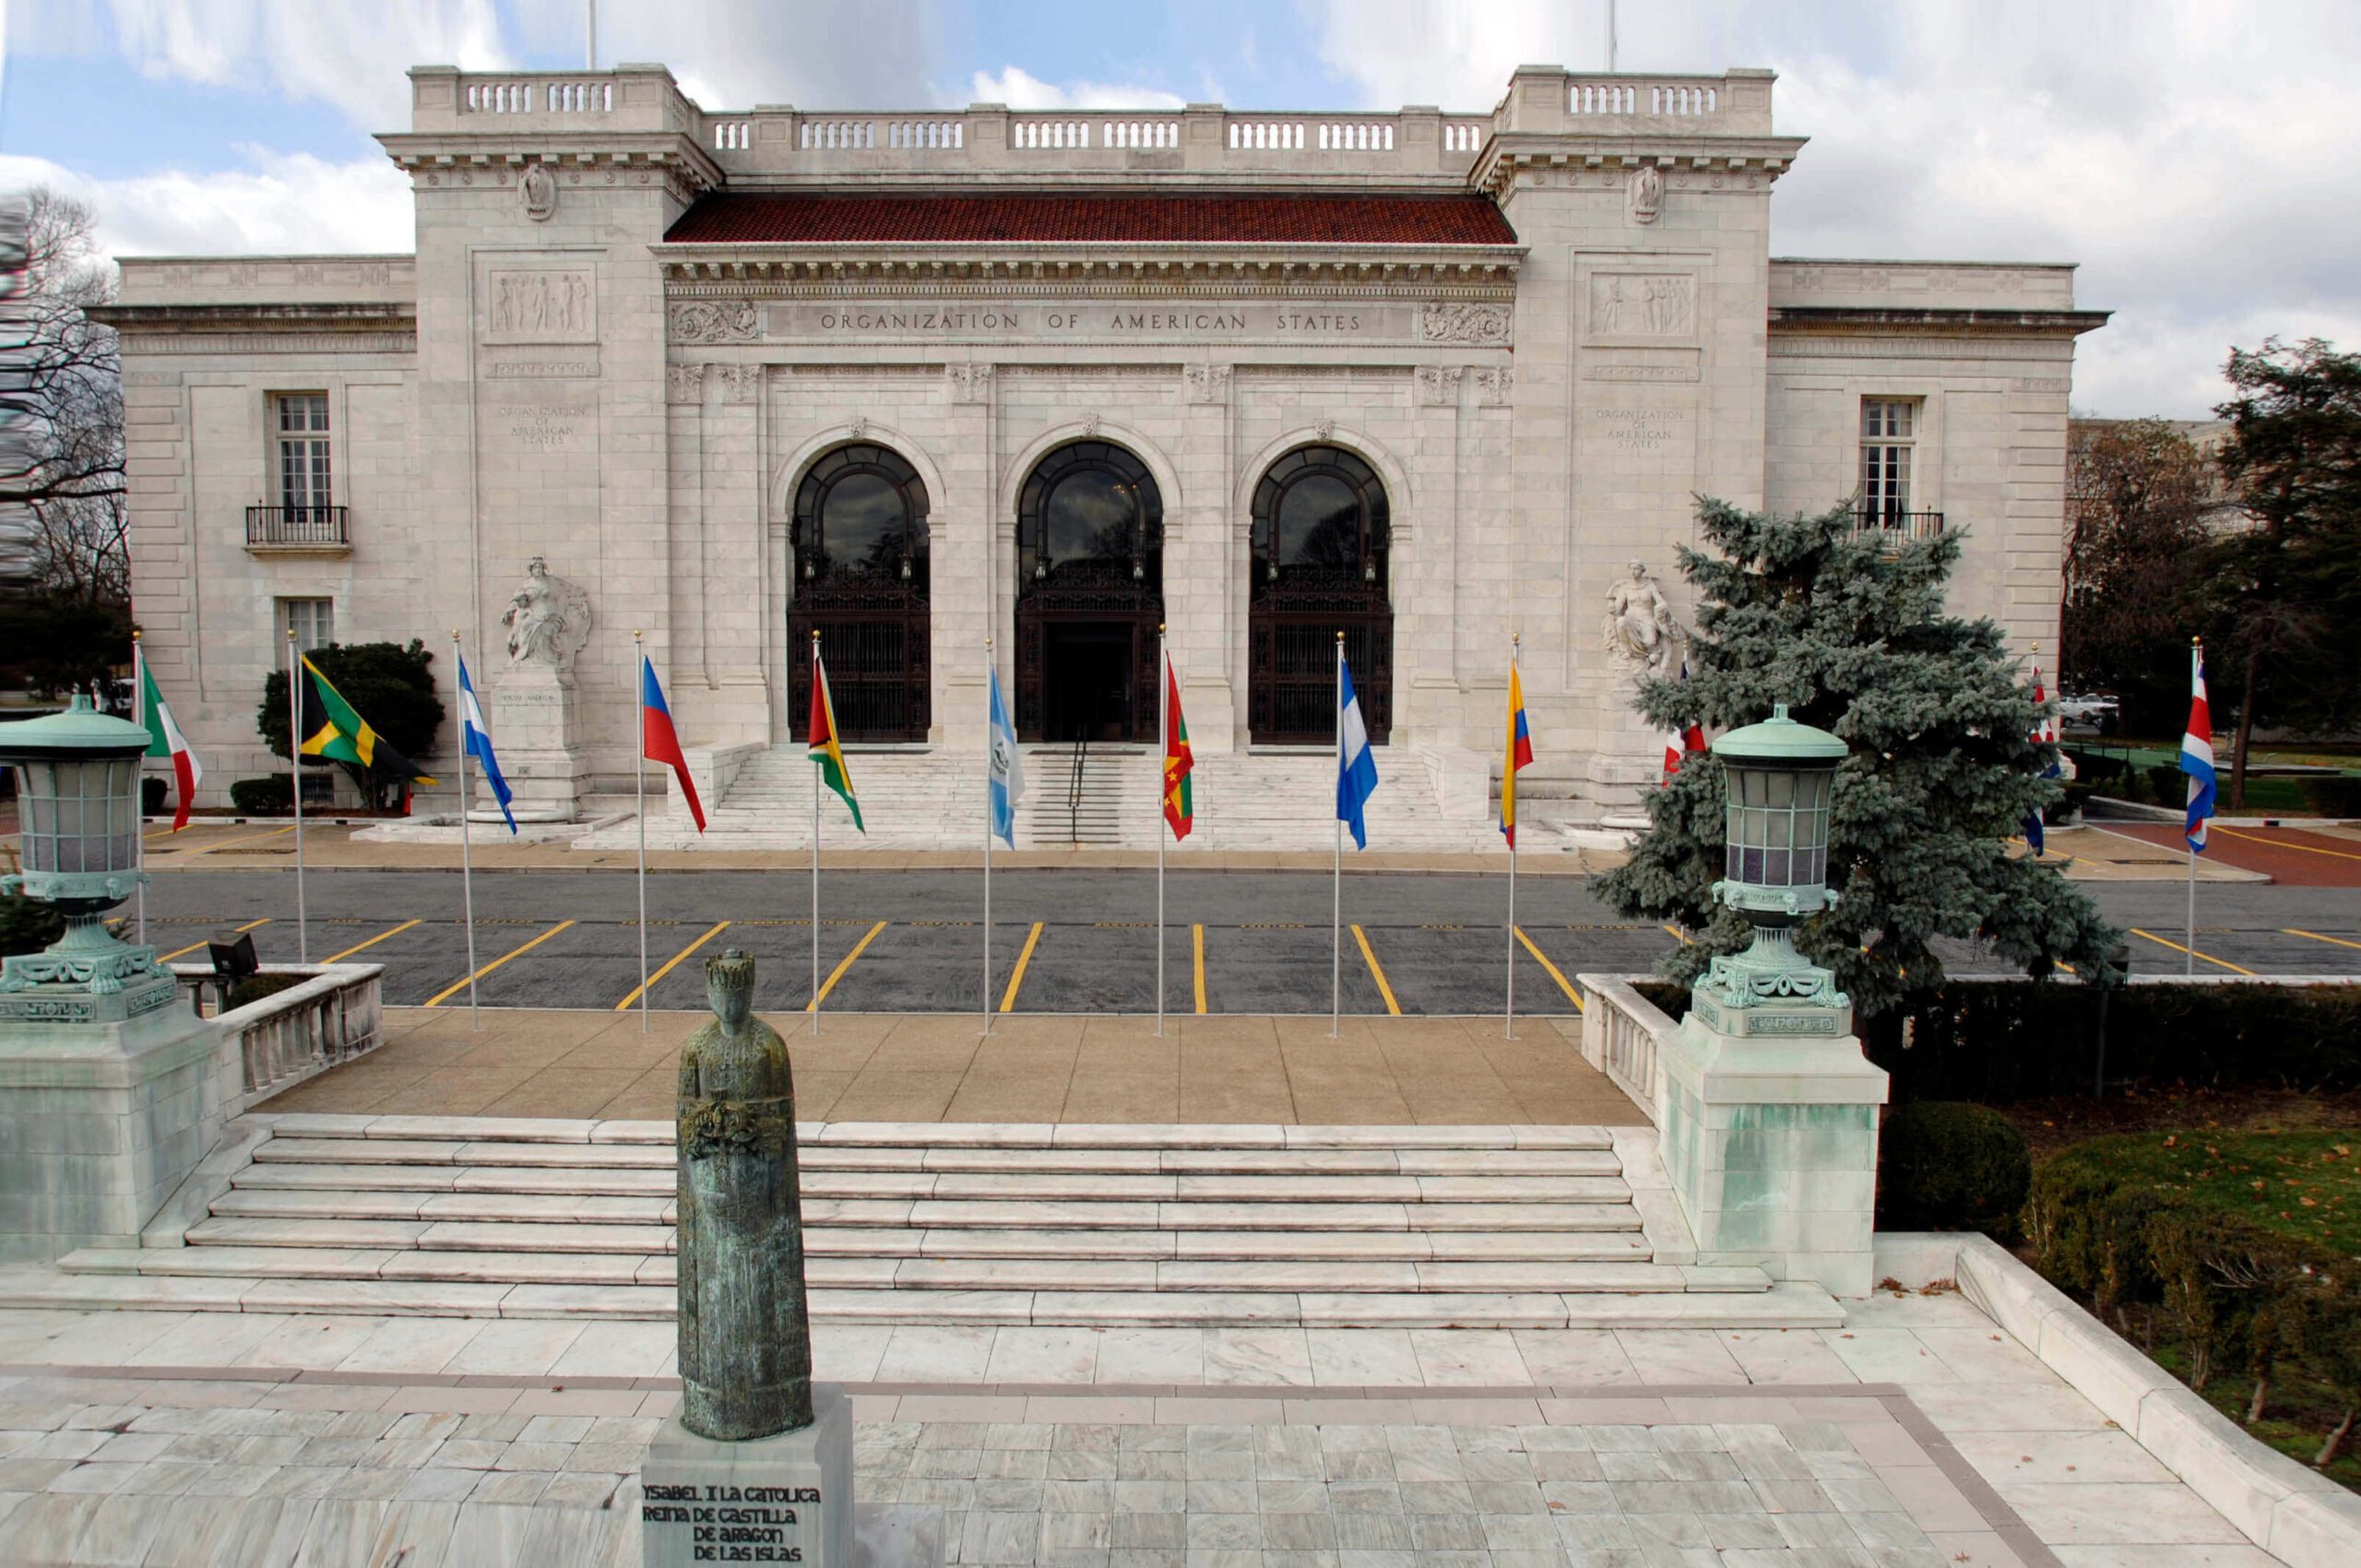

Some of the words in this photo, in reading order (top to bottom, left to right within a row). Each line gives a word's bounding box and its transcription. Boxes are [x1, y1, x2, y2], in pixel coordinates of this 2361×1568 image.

[820, 314, 1017, 329] ORGANIZATION
[1048, 314, 1078, 328] OF
[1110, 314, 1245, 329] AMERICAN
[1276, 315, 1360, 330] STATES
[499, 407, 586, 416] ORGANIZATION
[1596, 410, 1683, 420] ORGANIZATION
[1632, 421, 1645, 429] OF
[511, 426, 574, 436] AMERICAN
[1608, 430, 1671, 439] AMERICAN
[1618, 440, 1660, 449] STATES
